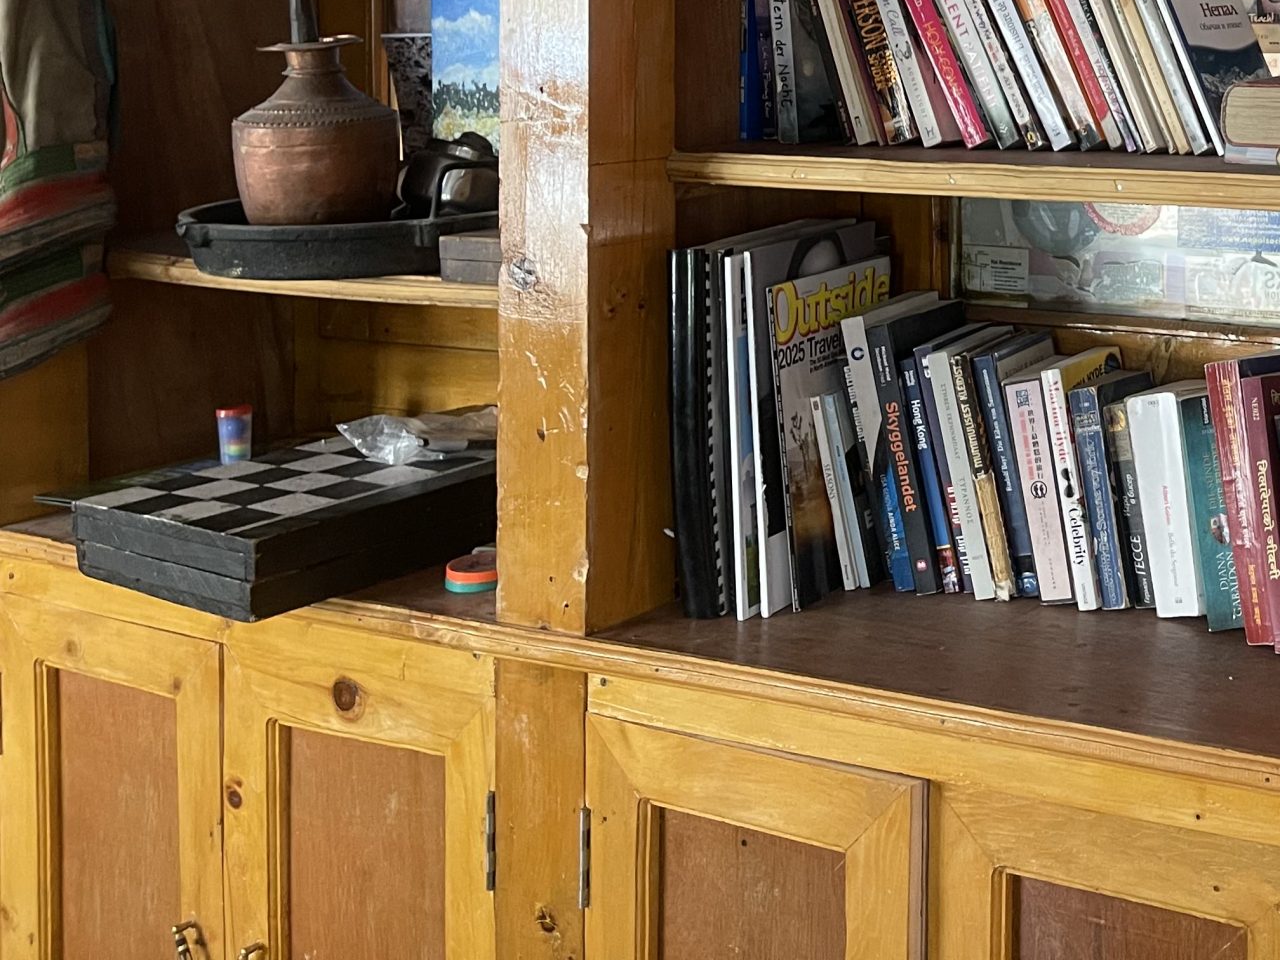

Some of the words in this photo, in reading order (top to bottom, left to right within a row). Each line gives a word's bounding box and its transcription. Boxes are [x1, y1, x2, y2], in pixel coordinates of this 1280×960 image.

[1200, 2, 1238, 17] Непал
[774, 266, 890, 345] Outside
[910, 399, 921, 424] Hong
[1048, 379, 1061, 428] Marina
[1055, 432, 1068, 464] Hyde
[884, 402, 916, 512] Skyggelandet
[915, 424, 928, 450] Kong
[822, 463, 836, 501] SEASONS
[1068, 507, 1086, 568] Celebrity
[1215, 551, 1229, 591] DIANA
[1226, 551, 1242, 620] GABALDON
